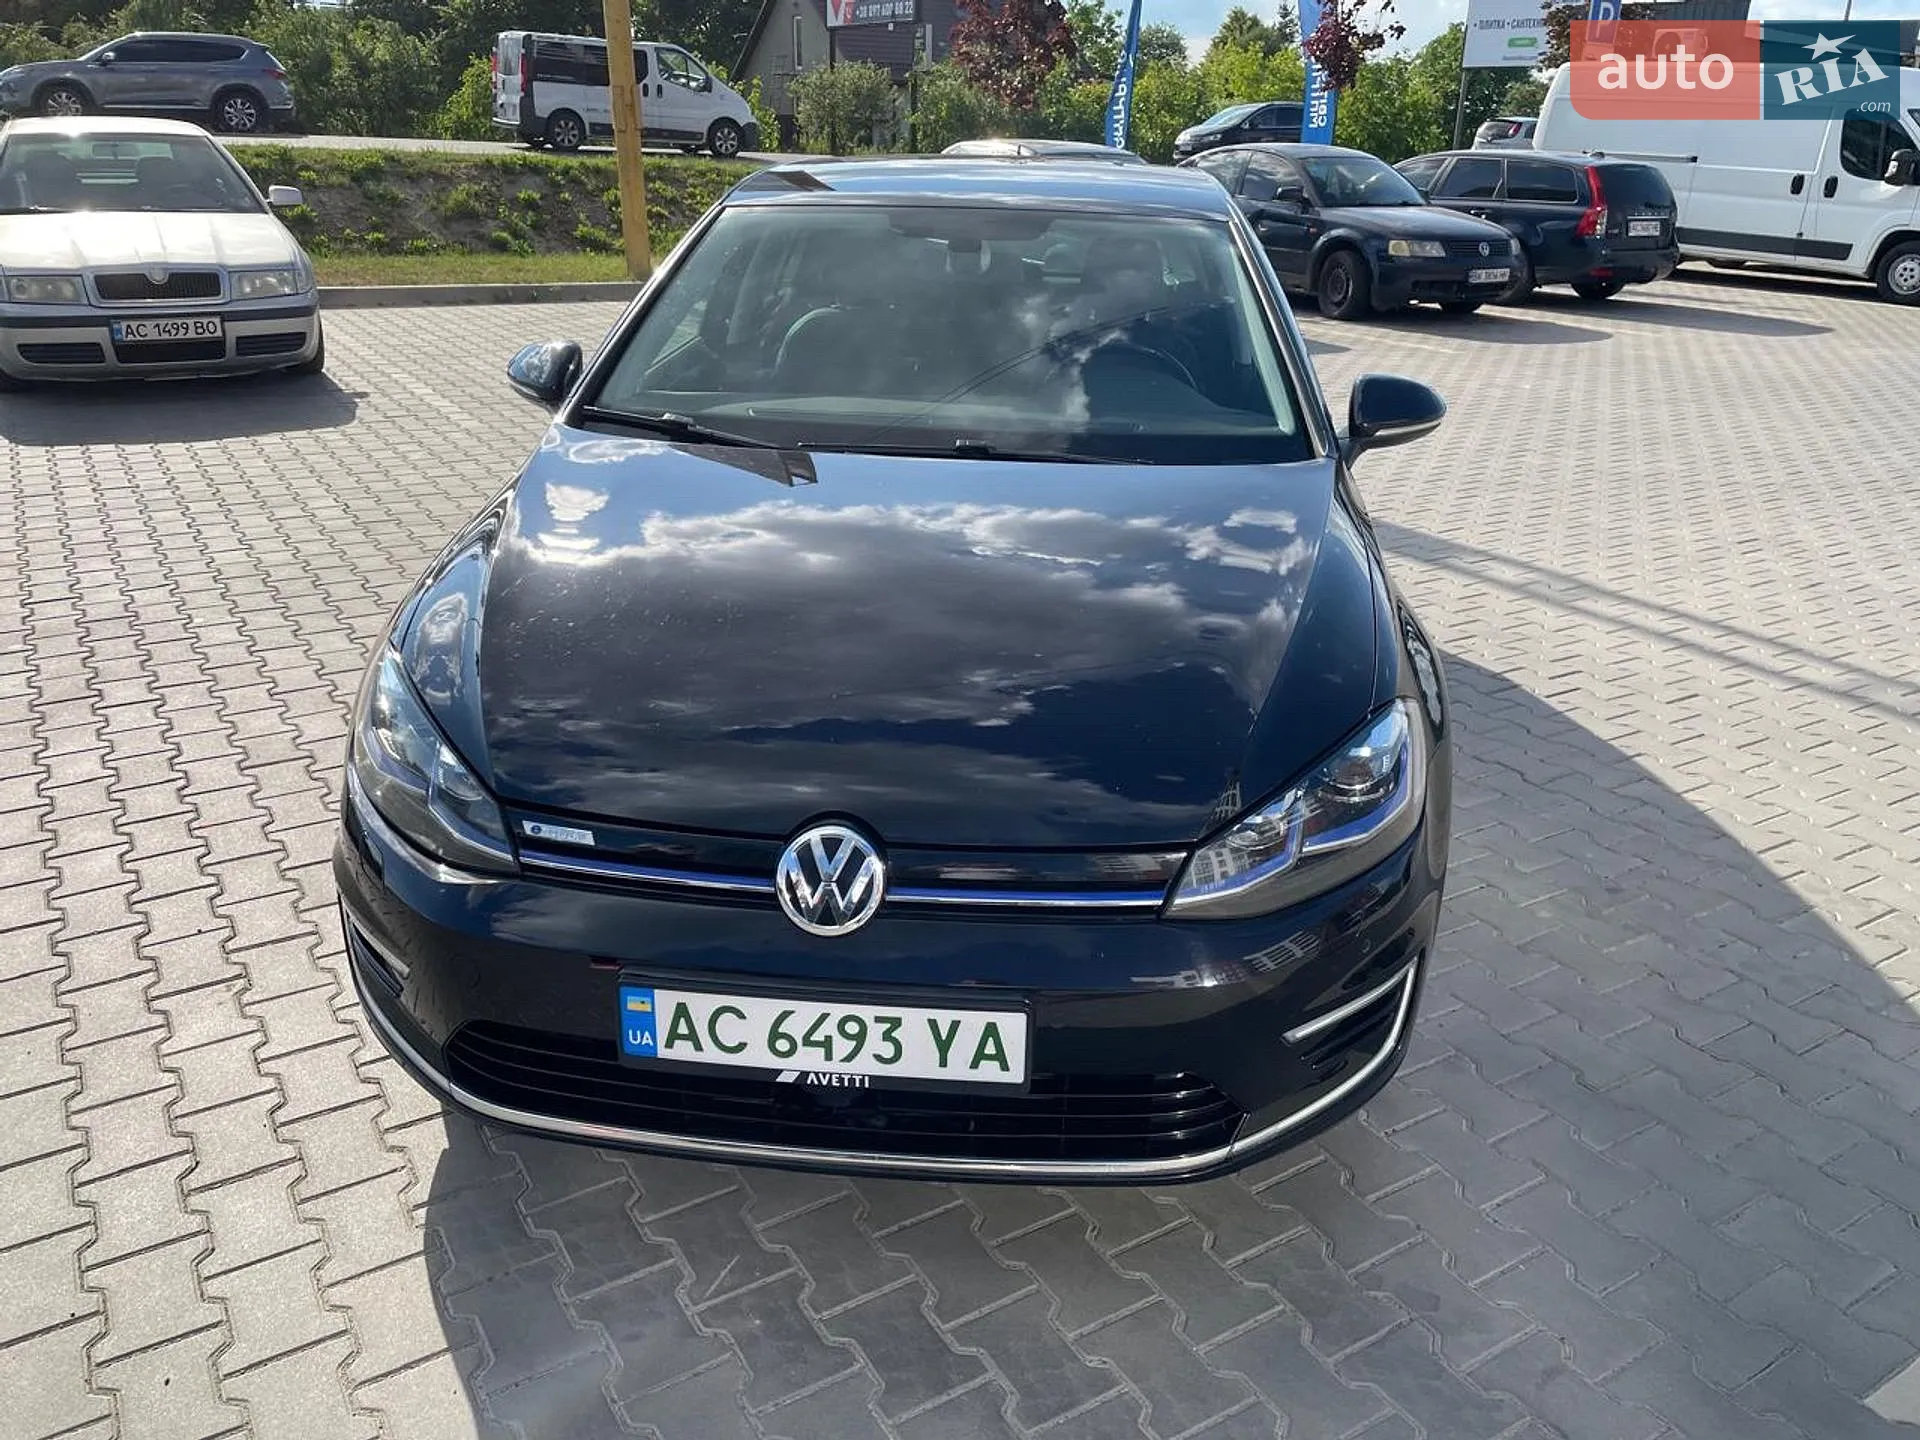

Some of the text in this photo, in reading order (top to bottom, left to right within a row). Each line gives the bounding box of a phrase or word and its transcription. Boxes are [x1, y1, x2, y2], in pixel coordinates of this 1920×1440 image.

[125, 320, 218, 338] AC 1499 BO
[628, 1029, 654, 1047] UA
[664, 1001, 1010, 1072] AC 6493 YA
[805, 1071, 870, 1089] AVETTI
